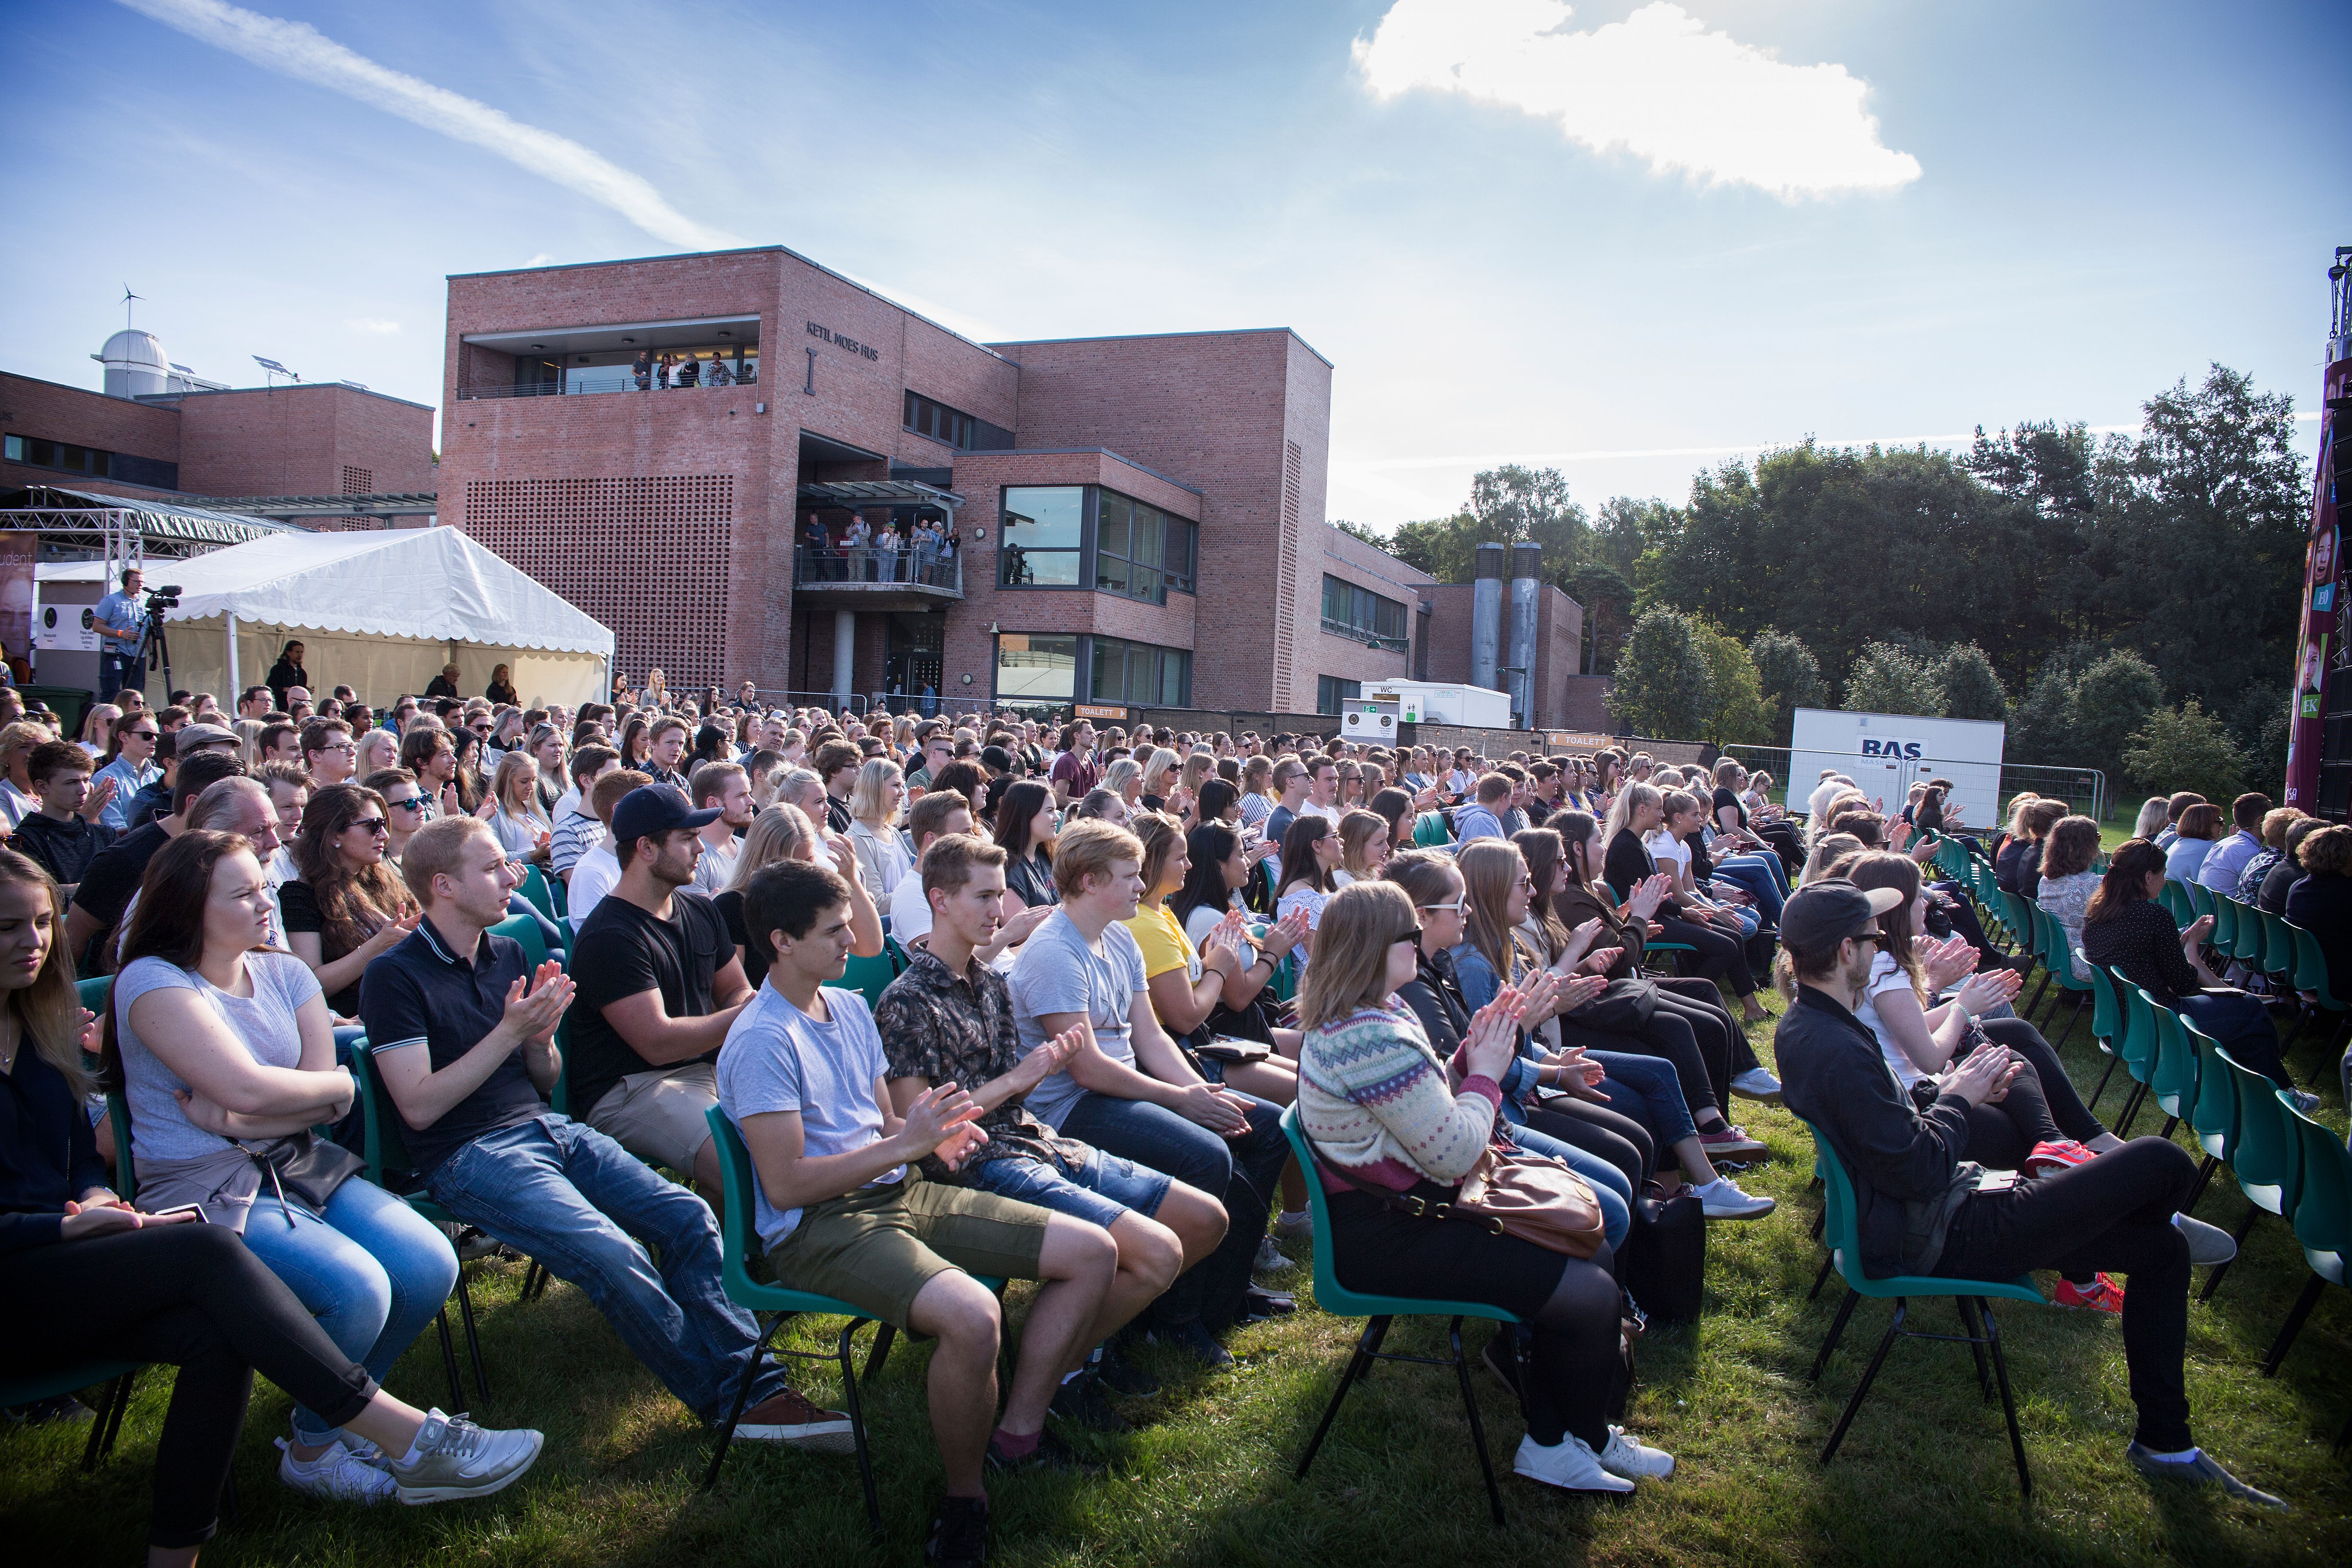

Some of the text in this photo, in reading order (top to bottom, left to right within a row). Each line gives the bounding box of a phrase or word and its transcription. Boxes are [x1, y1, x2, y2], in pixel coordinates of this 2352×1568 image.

[807, 321, 879, 361] KETIL MOES HUS
[1081, 707, 1113, 716] TOALETT
[1565, 736, 1606, 746] TOALETT
[1862, 739, 1921, 761] BAS
